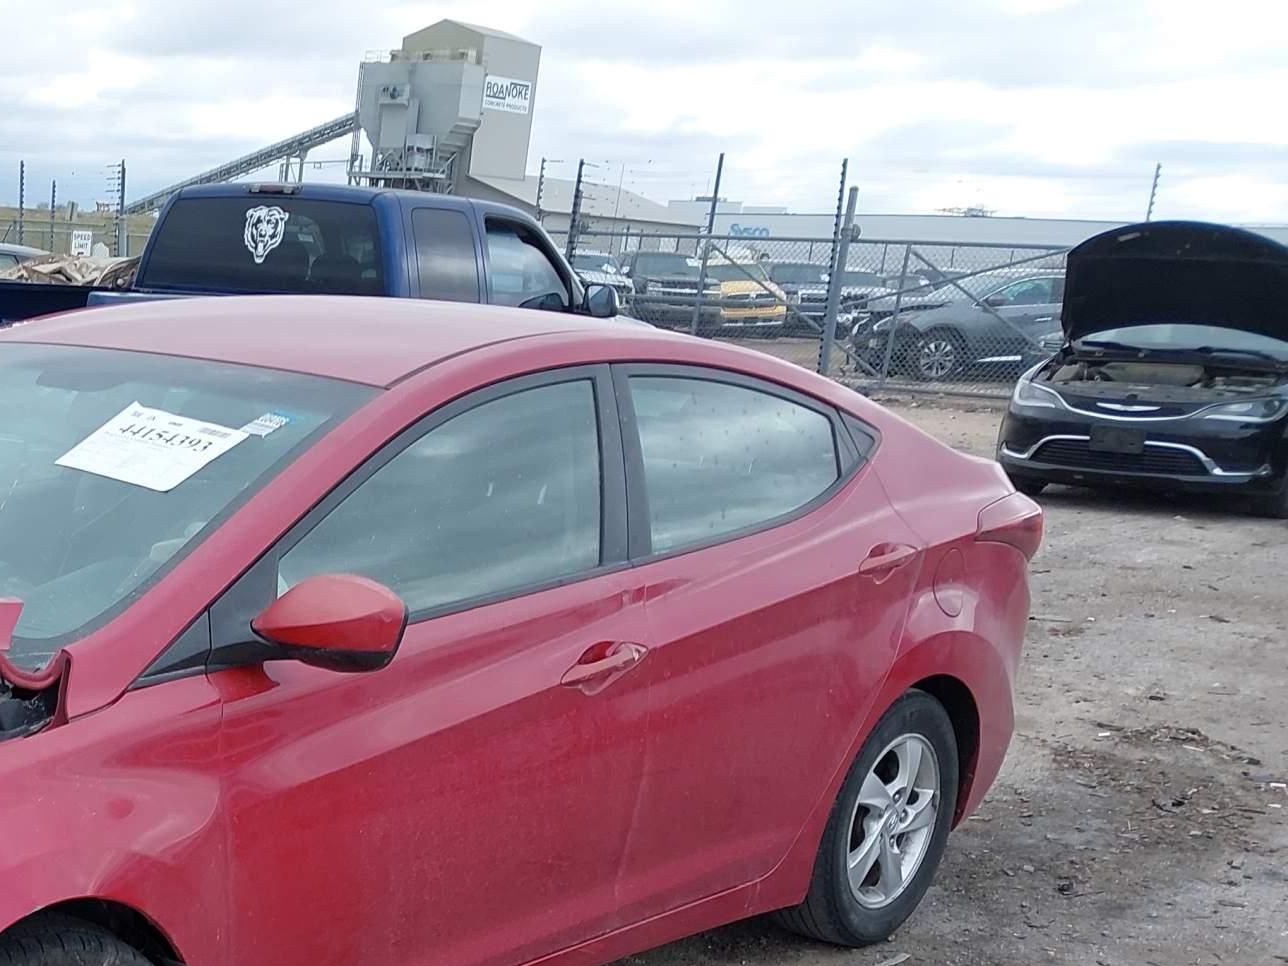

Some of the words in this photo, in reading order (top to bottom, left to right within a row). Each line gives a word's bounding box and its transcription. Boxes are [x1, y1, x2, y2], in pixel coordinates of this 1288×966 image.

[486, 82, 529, 100] ROANOKE
[485, 100, 506, 108] CONCRETE
[507, 104, 527, 113] PRODUCTS
[74, 233, 91, 241] SPEED
[74, 241, 88, 249] LIMIT
[119, 424, 213, 452] 44154393
